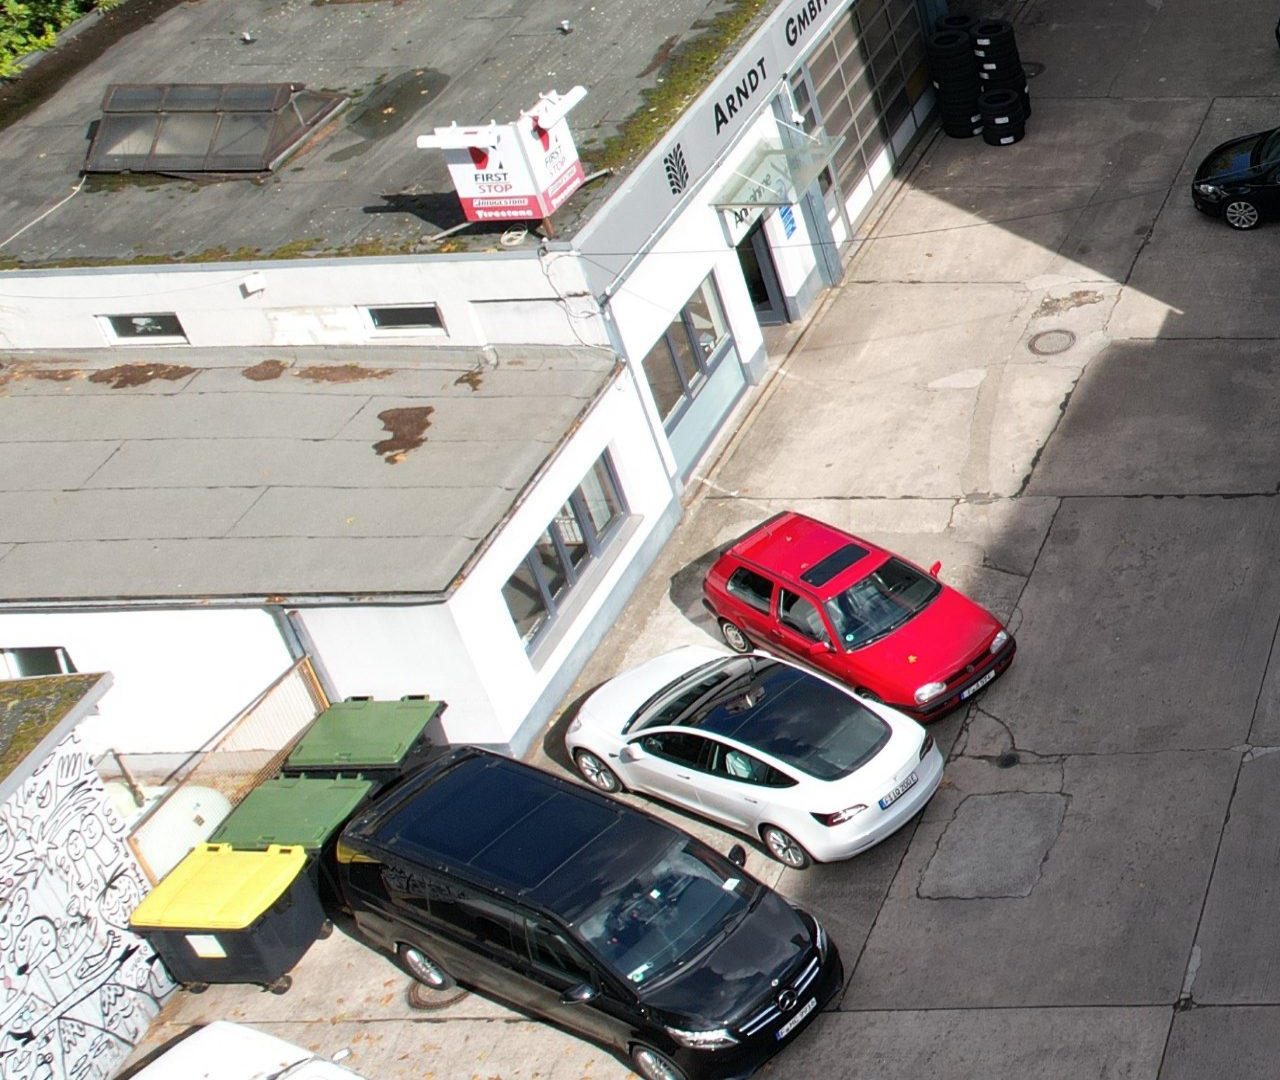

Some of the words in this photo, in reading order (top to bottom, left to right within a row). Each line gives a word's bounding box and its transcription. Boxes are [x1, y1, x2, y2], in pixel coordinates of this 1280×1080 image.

[713, 57, 767, 135] ARNDT
[474, 172, 509, 182] FIRST
[478, 183, 513, 194] STOP
[475, 209, 533, 219] Firestone
